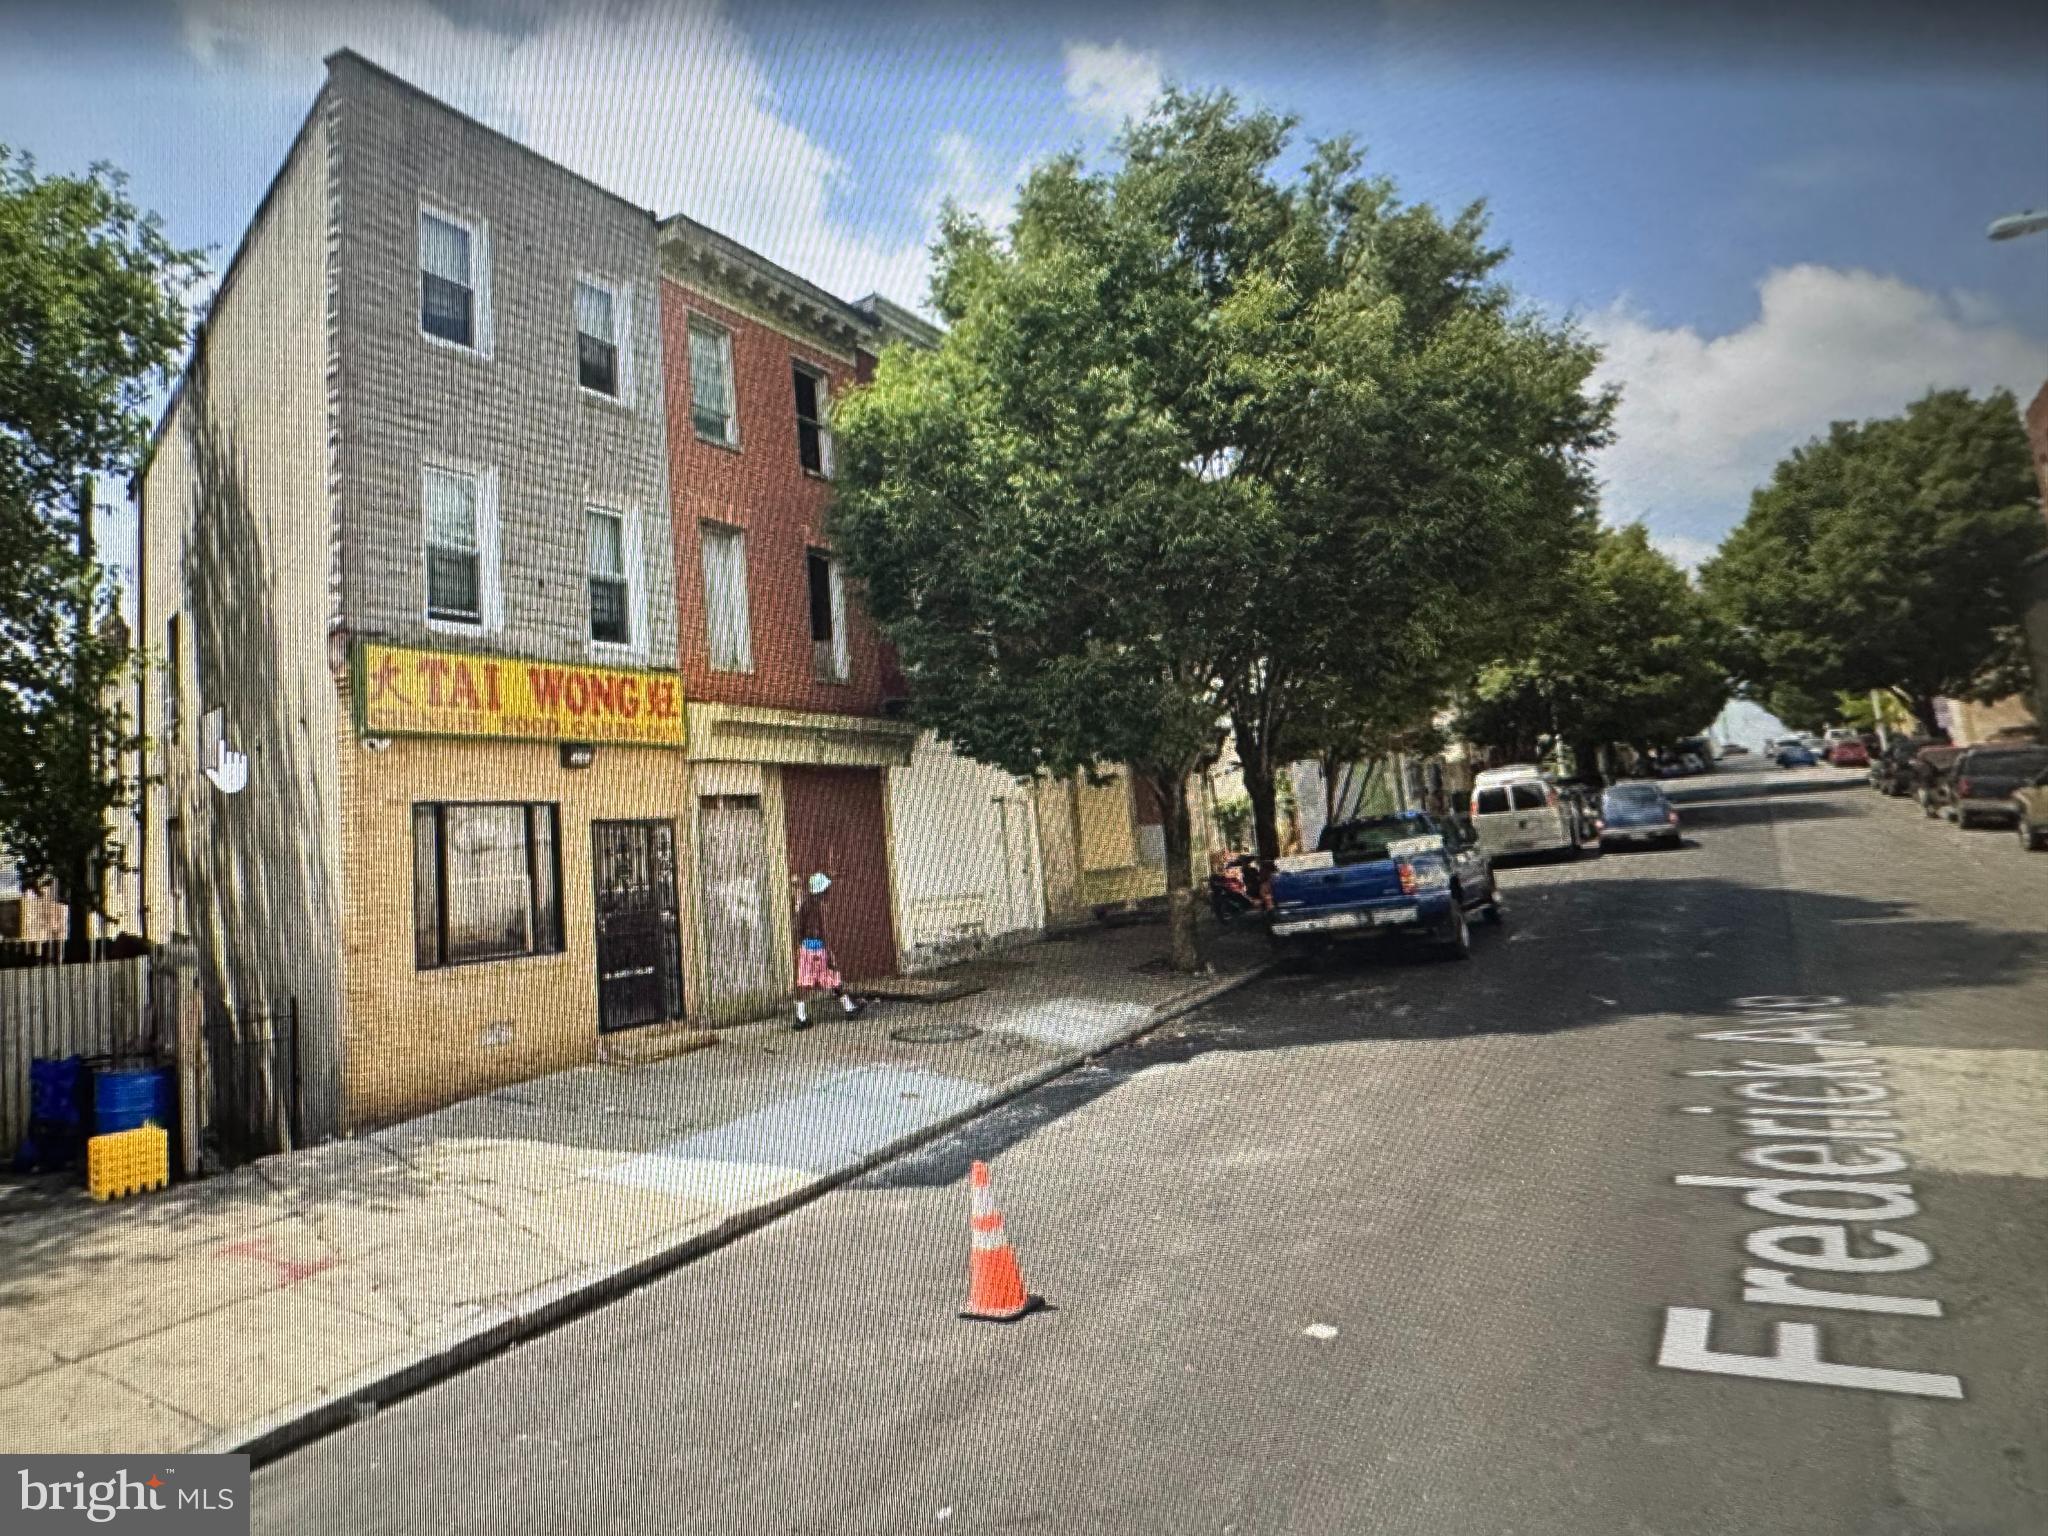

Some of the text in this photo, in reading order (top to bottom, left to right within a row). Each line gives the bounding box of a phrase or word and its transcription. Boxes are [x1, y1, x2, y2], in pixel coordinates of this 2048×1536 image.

[417, 657, 502, 712] TAI
[527, 666, 640, 719] WONG
[1658, 1059, 1964, 1400] Frederick
